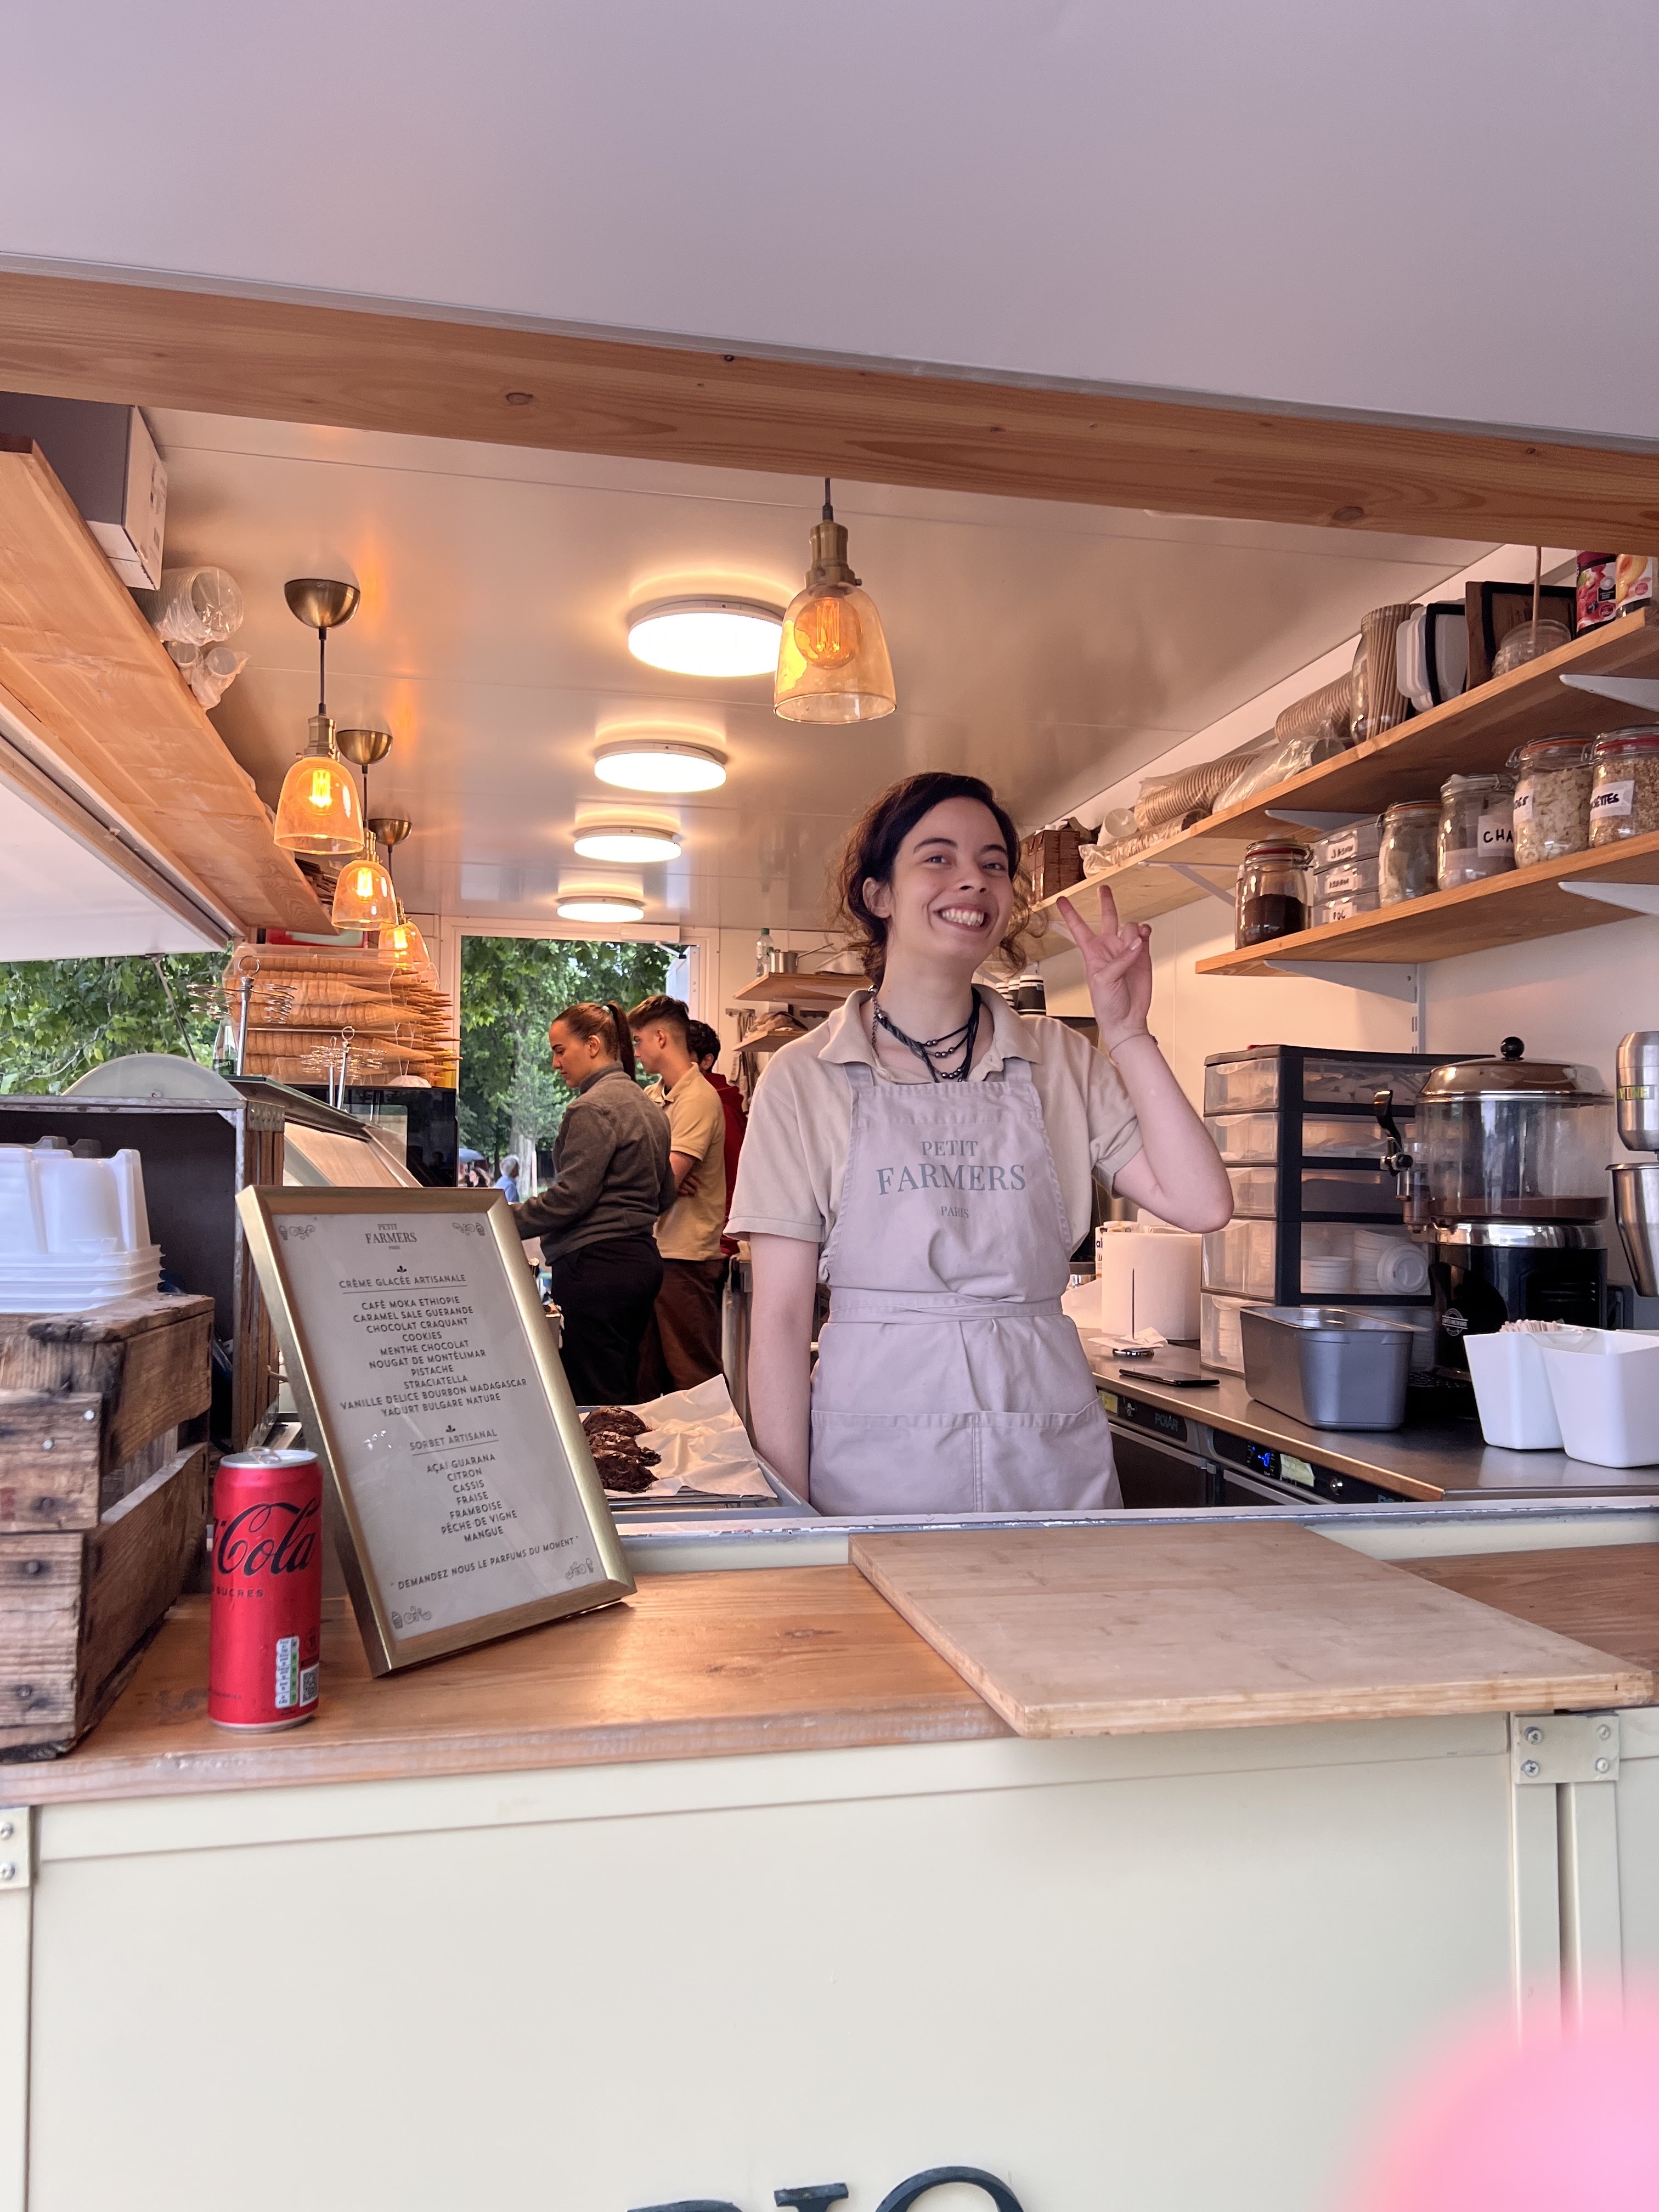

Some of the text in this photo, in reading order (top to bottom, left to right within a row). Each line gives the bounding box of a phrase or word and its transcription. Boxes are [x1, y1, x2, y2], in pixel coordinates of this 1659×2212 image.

[921, 1141, 978, 1156] PETIT
[876, 1163, 1025, 1196] FARMERS
[941, 1206, 969, 1218] PARIS
[365, 1232, 417, 1244] FARMERS
[339, 1274, 466, 1288] CRÊME GLACÉE ARTISANALE
[362, 1300, 386, 1310] CAFÉ
[419, 1296, 460, 1306] ETHIOPIE
[353, 1306, 473, 1323] CARAMEL SALE GUERANDE
[366, 1318, 467, 1333] CHOCOLAT CRAQUANT
[403, 1331, 442, 1342] COOKIES
[380, 1340, 469, 1356] MENTHE CHOCOLAT
[369, 1349, 486, 1369] NOUGAT DE MONTÉLIMAR
[411, 1364, 454, 1376] PISTACHE
[404, 1375, 469, 1389] STRACIATELLA
[340, 1379, 527, 1410] VANILLE DELICE BOURBON MADAGASCAR
[381, 1393, 501, 1417] YAOURT BULGARE NATURE
[1154, 1412, 1178, 1432] POLAR
[410, 1429, 498, 1451] SORBET ARTISANAL
[452, 1453, 496, 1468] GUARANA
[447, 1468, 482, 1482] CITRON
[453, 1480, 484, 1493] CASSIS
[456, 1491, 489, 1505] FRAISE
[449, 1500, 503, 1520] FRAMBOISE
[441, 1510, 517, 1535] PÊCHE DE VIGNE
[464, 1526, 504, 1543] MANGUE
[398, 1570, 449, 1590] DEMANDEZ
[452, 1563, 475, 1576] NOUS
[478, 1560, 488, 1569] LE
[490, 1549, 527, 1566] PARFUMS
[529, 1547, 540, 1555] DU
[543, 1537, 574, 1552] MOMENT
